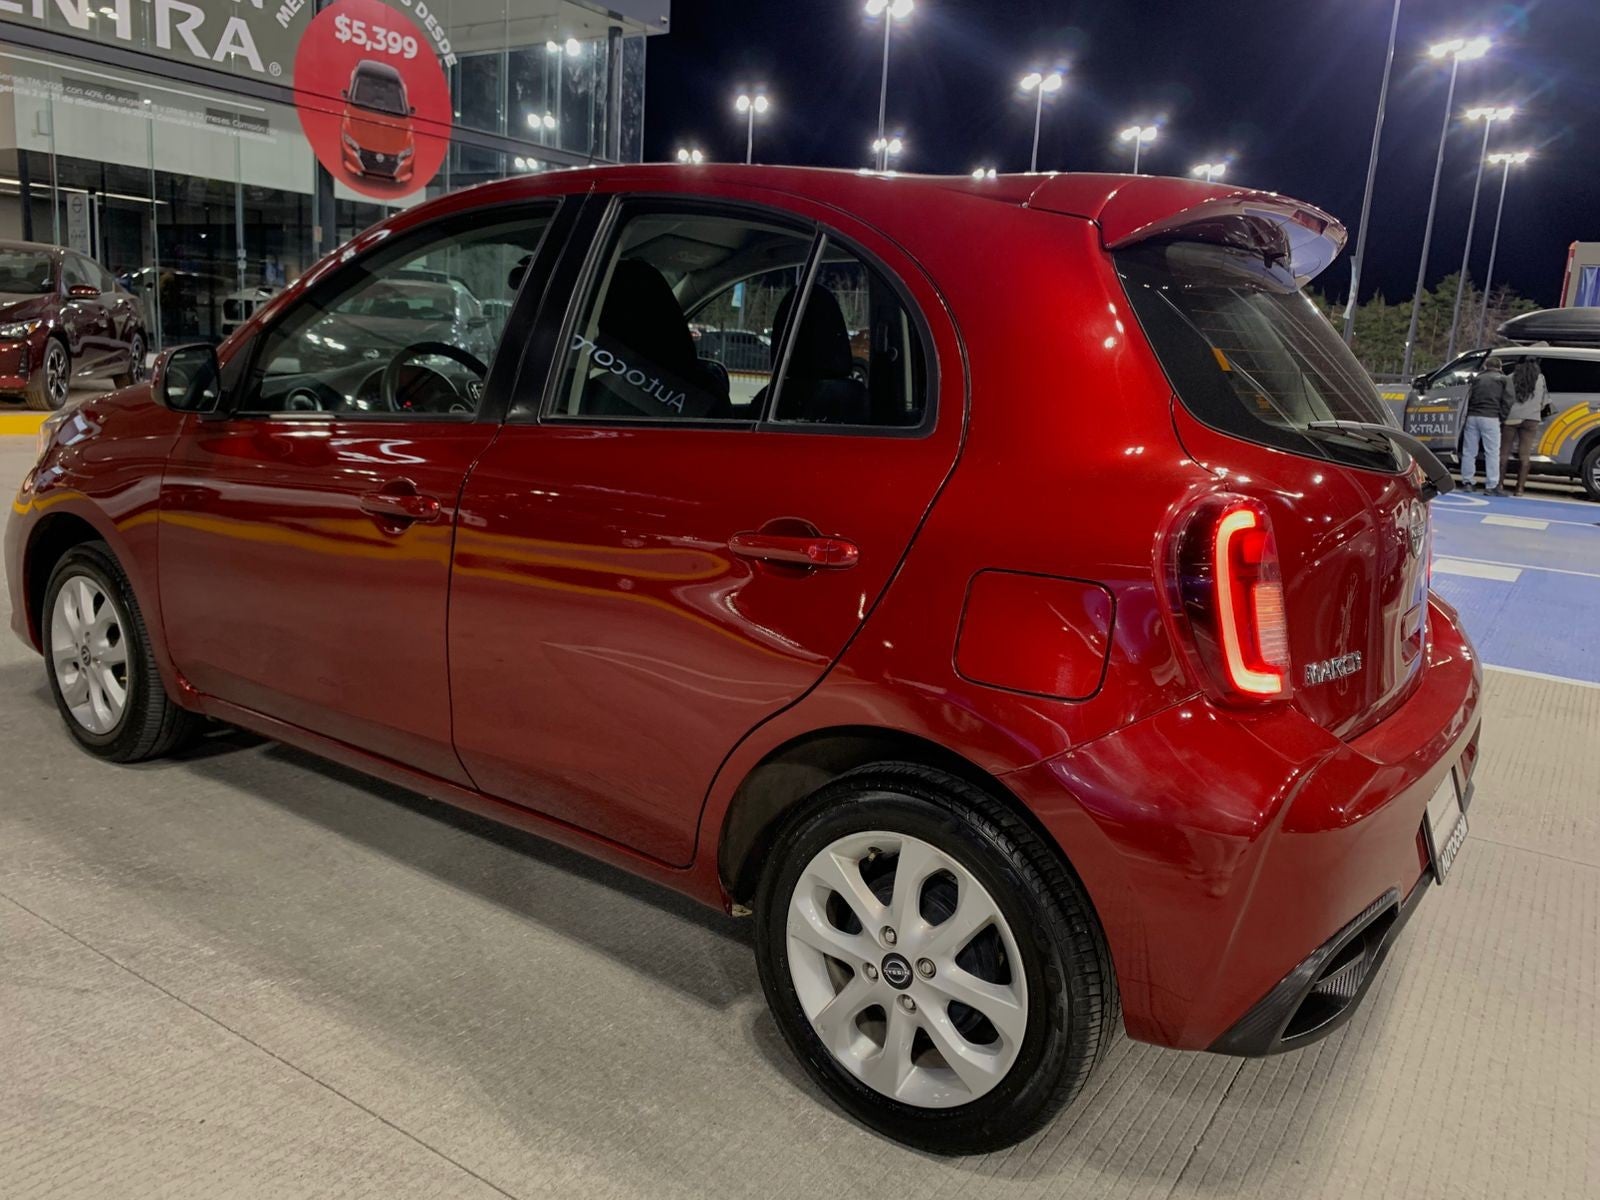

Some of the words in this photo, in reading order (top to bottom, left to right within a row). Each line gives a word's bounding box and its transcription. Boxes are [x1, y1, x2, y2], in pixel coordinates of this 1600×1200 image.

[334, 13, 418, 59] $5,399
[414, 1, 458, 68] DESDE
[1410, 413, 1454, 422] NISSAN
